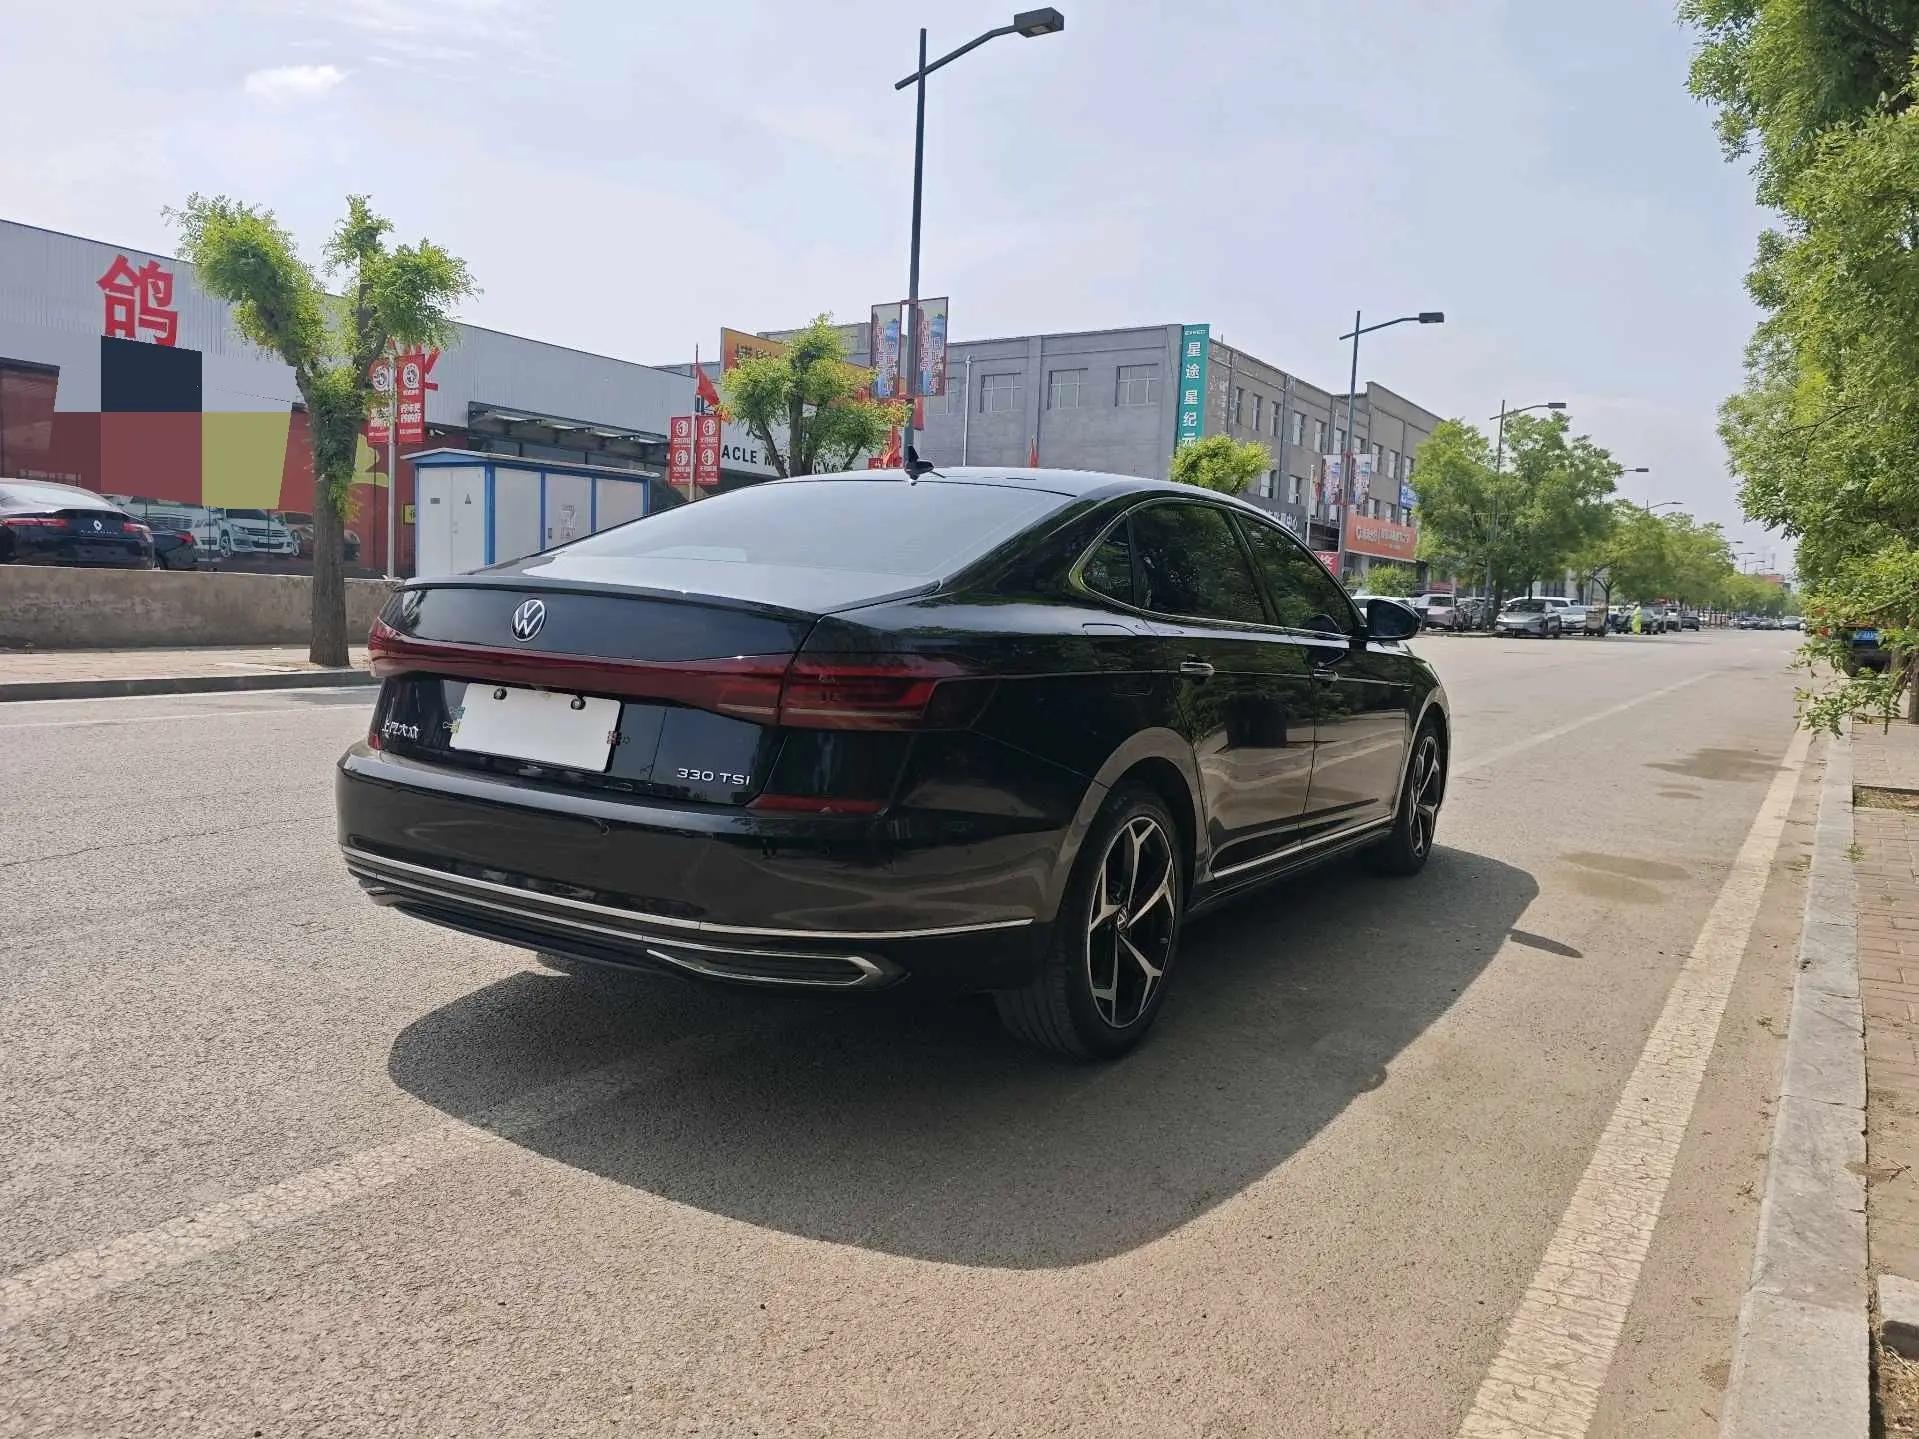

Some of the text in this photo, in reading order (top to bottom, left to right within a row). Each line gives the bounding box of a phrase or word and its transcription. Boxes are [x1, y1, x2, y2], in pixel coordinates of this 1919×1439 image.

[1182, 341, 1201, 447] 星途星纪元
[677, 763, 750, 785] 330 TSI
